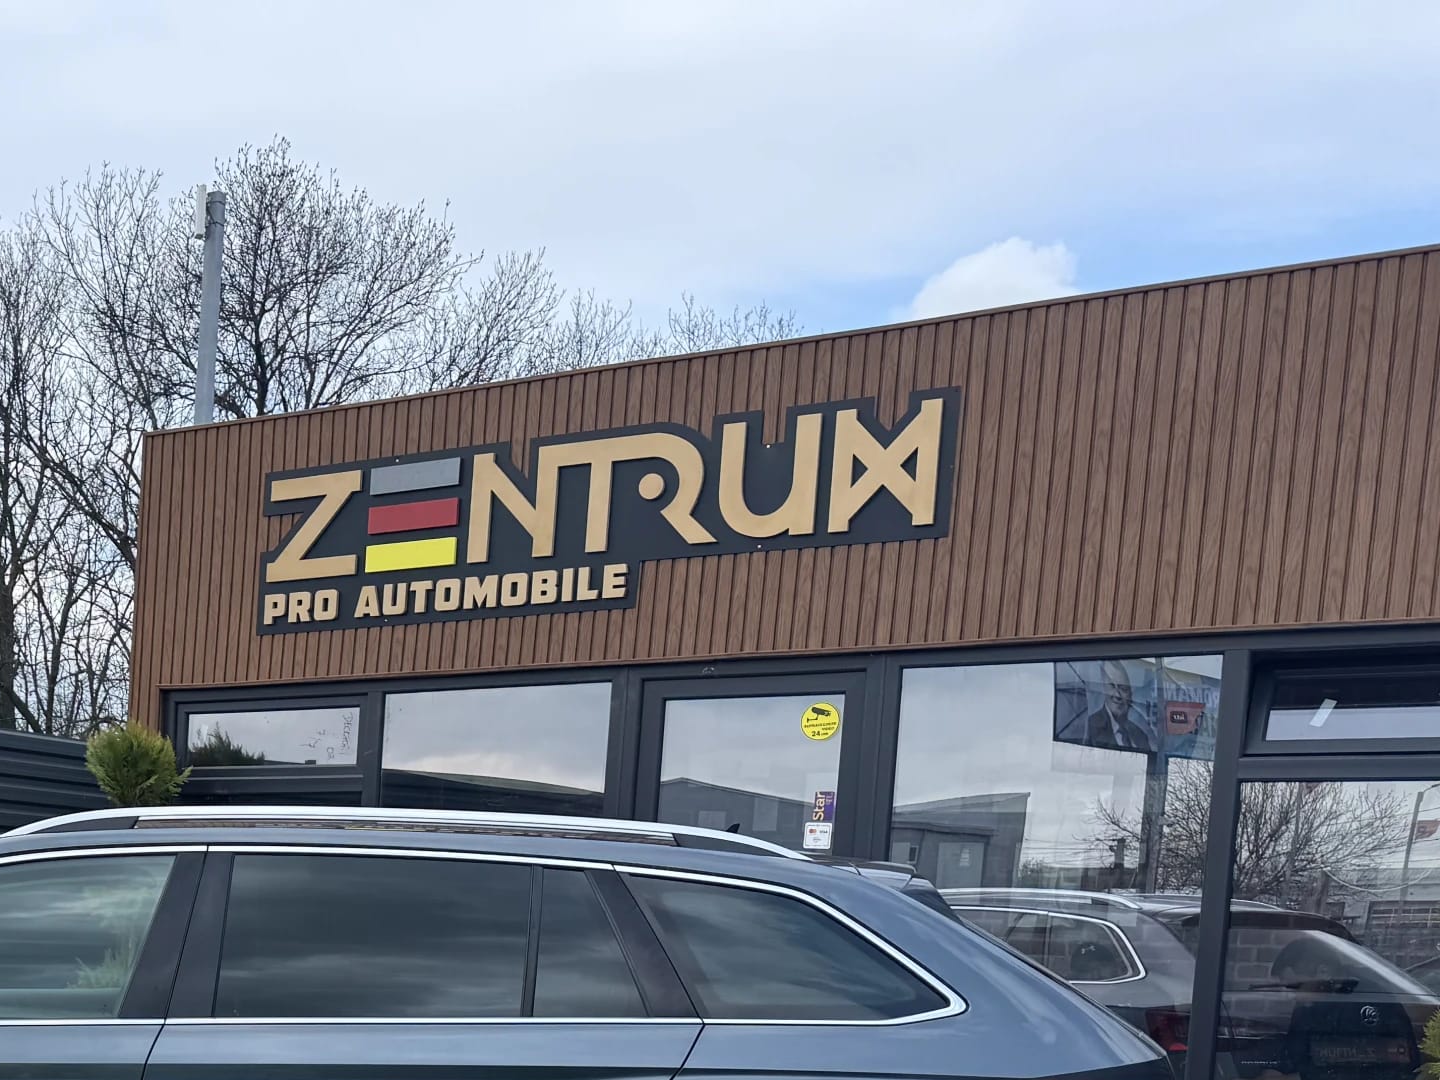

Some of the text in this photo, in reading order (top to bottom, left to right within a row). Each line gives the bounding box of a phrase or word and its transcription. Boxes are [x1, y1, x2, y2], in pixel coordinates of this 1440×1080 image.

[265, 397, 945, 584] ZENTRUM
[263, 562, 629, 625] PRO AUTOMOBILE
[813, 791, 825, 821] Star
